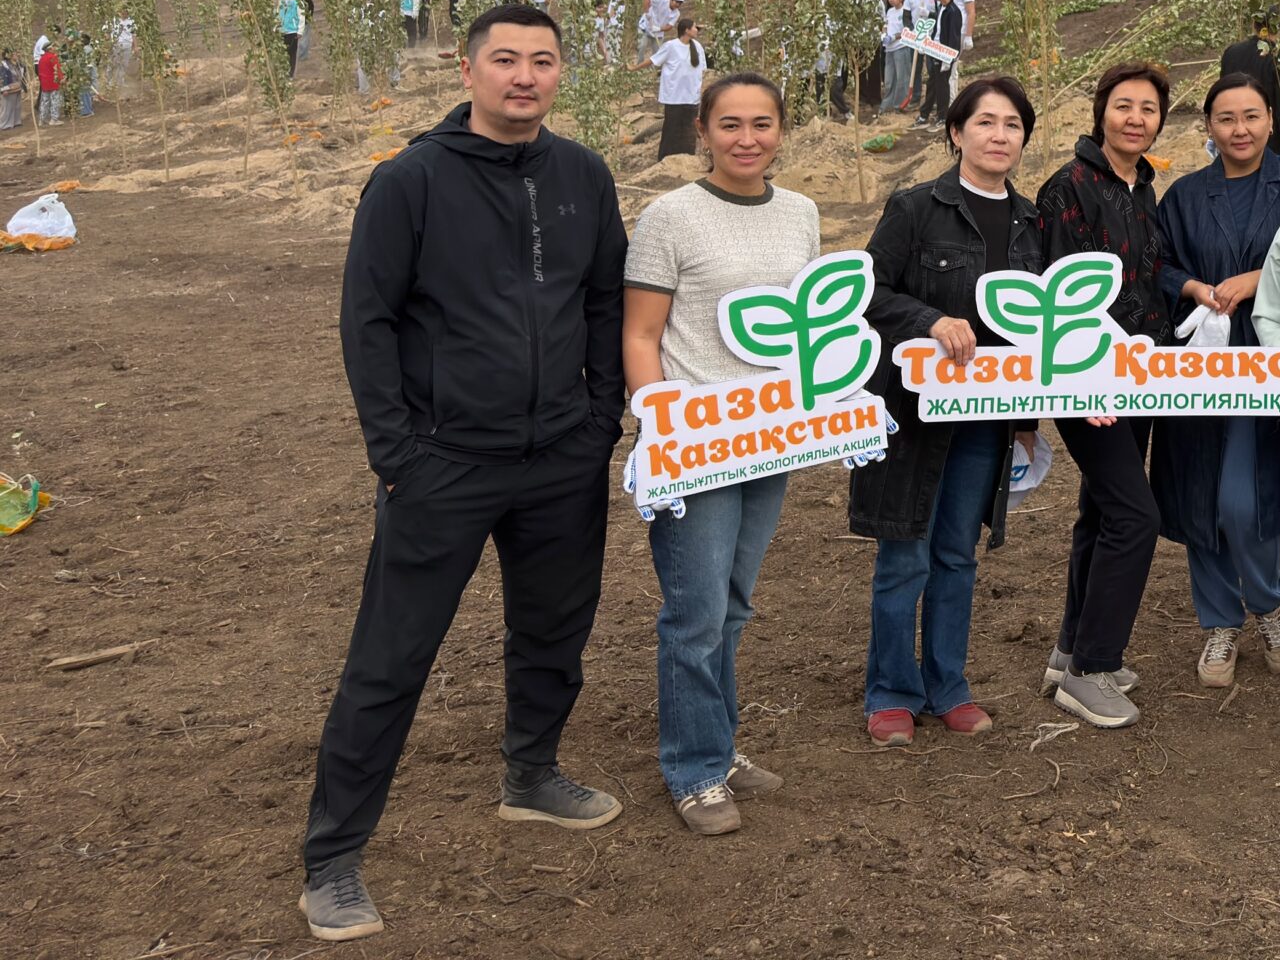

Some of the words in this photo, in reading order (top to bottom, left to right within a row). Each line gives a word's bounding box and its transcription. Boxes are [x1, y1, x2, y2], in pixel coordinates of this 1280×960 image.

[524, 177, 538, 221] UNDER
[532, 223, 544, 282] ARMOUR
[901, 347, 1034, 385] Таза
[643, 379, 794, 436] Таза
[926, 393, 1107, 416] ЖАЛПЫҰЛТТЫҚ
[647, 404, 878, 480] Қазақстан
[647, 465, 747, 499] ЖАЛПЫҰЛТТЫҚ
[749, 446, 840, 474] ЭКОЛОГИЯЛЫҚ
[842, 435, 881, 454] АКЦИЯ
